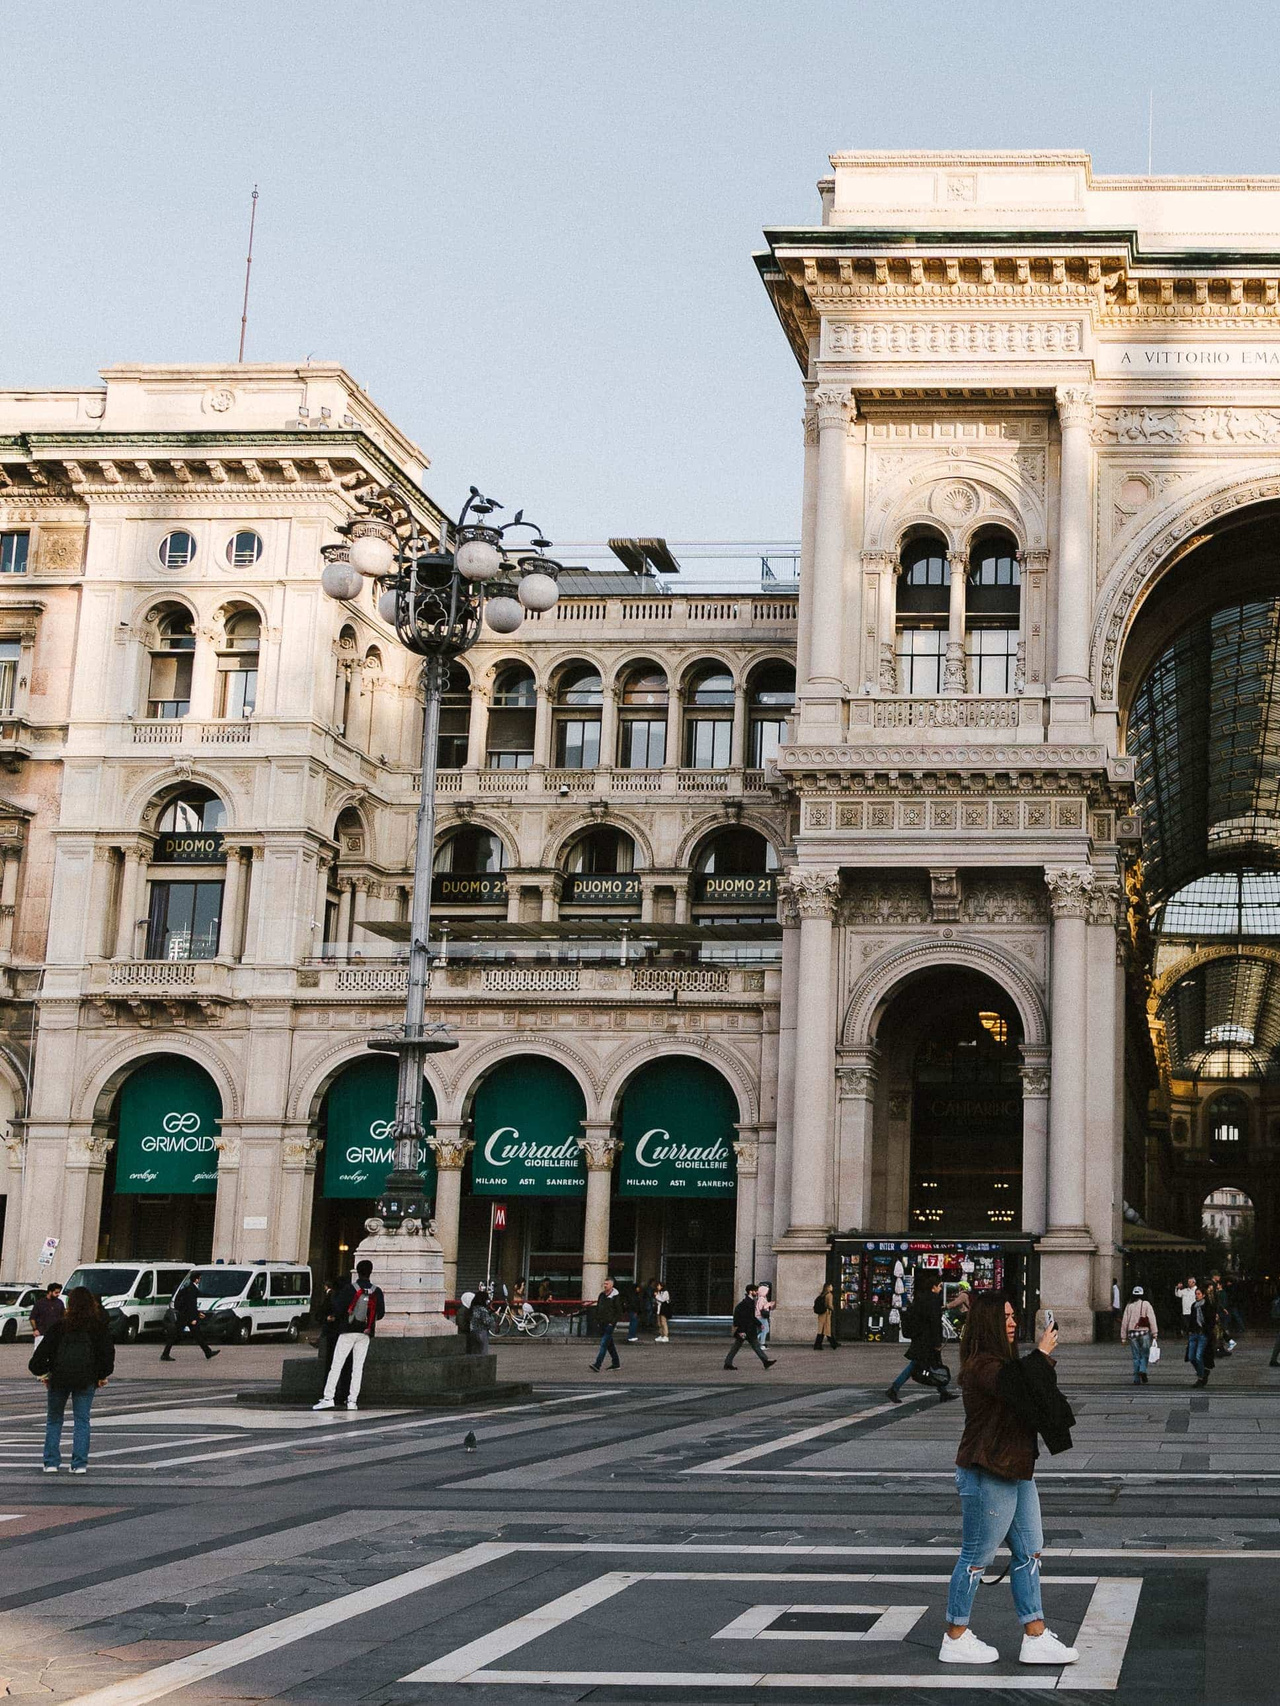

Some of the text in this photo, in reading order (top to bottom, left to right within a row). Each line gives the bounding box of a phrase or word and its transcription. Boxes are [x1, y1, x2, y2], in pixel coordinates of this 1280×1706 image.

[1121, 352, 1131, 364] A
[1145, 351, 1230, 364] VITTORIO
[166, 840, 215, 852] DUOMO
[442, 881, 490, 893] DUOMO
[574, 881, 638, 893] DUOMO 21
[706, 880, 771, 892] DUOMO 21
[484, 1127, 580, 1166] Currado
[635, 1128, 729, 1168] Currado
[675, 1161, 728, 1169] GIOIELLERIE
[697, 1180, 734, 1188] SANREMO
[495, 1209, 506, 1225] M
